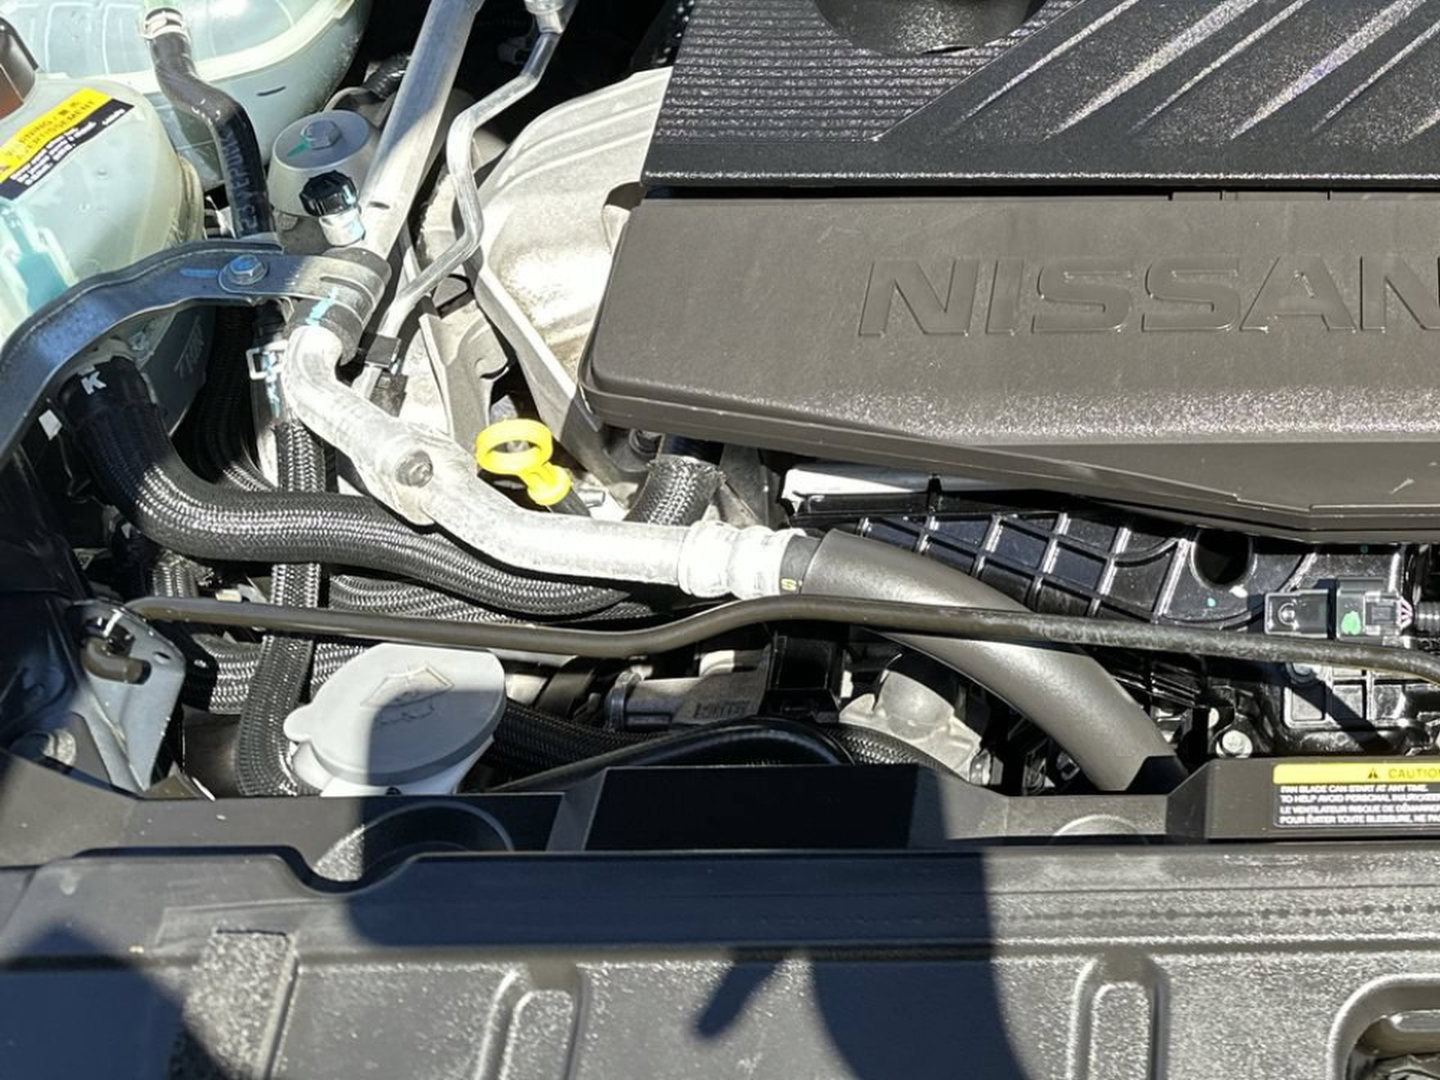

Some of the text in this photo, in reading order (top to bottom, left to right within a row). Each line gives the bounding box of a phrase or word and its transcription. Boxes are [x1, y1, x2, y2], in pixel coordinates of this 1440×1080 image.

[1299, 785, 1327, 793] BLADE
[1328, 785, 1347, 793] CAN
[1348, 784, 1375, 792] START
[1375, 784, 1388, 792] AT
[1387, 784, 1406, 792] ANY
[1280, 794, 1293, 803] TO
[1294, 794, 1317, 803] HELP
[1317, 794, 1345, 803] AVOID
[1345, 793, 1390, 803] PERSONAL
[1280, 805, 1292, 814] LE
[1291, 804, 1347, 814] VENTILATEUR
[1348, 804, 1380, 814] RISQUE
[1381, 804, 1394, 813] DE
[1280, 816, 1305, 824] POUR
[1337, 815, 1364, 824] TOUTE
[1413, 814, 1426, 823] NE
